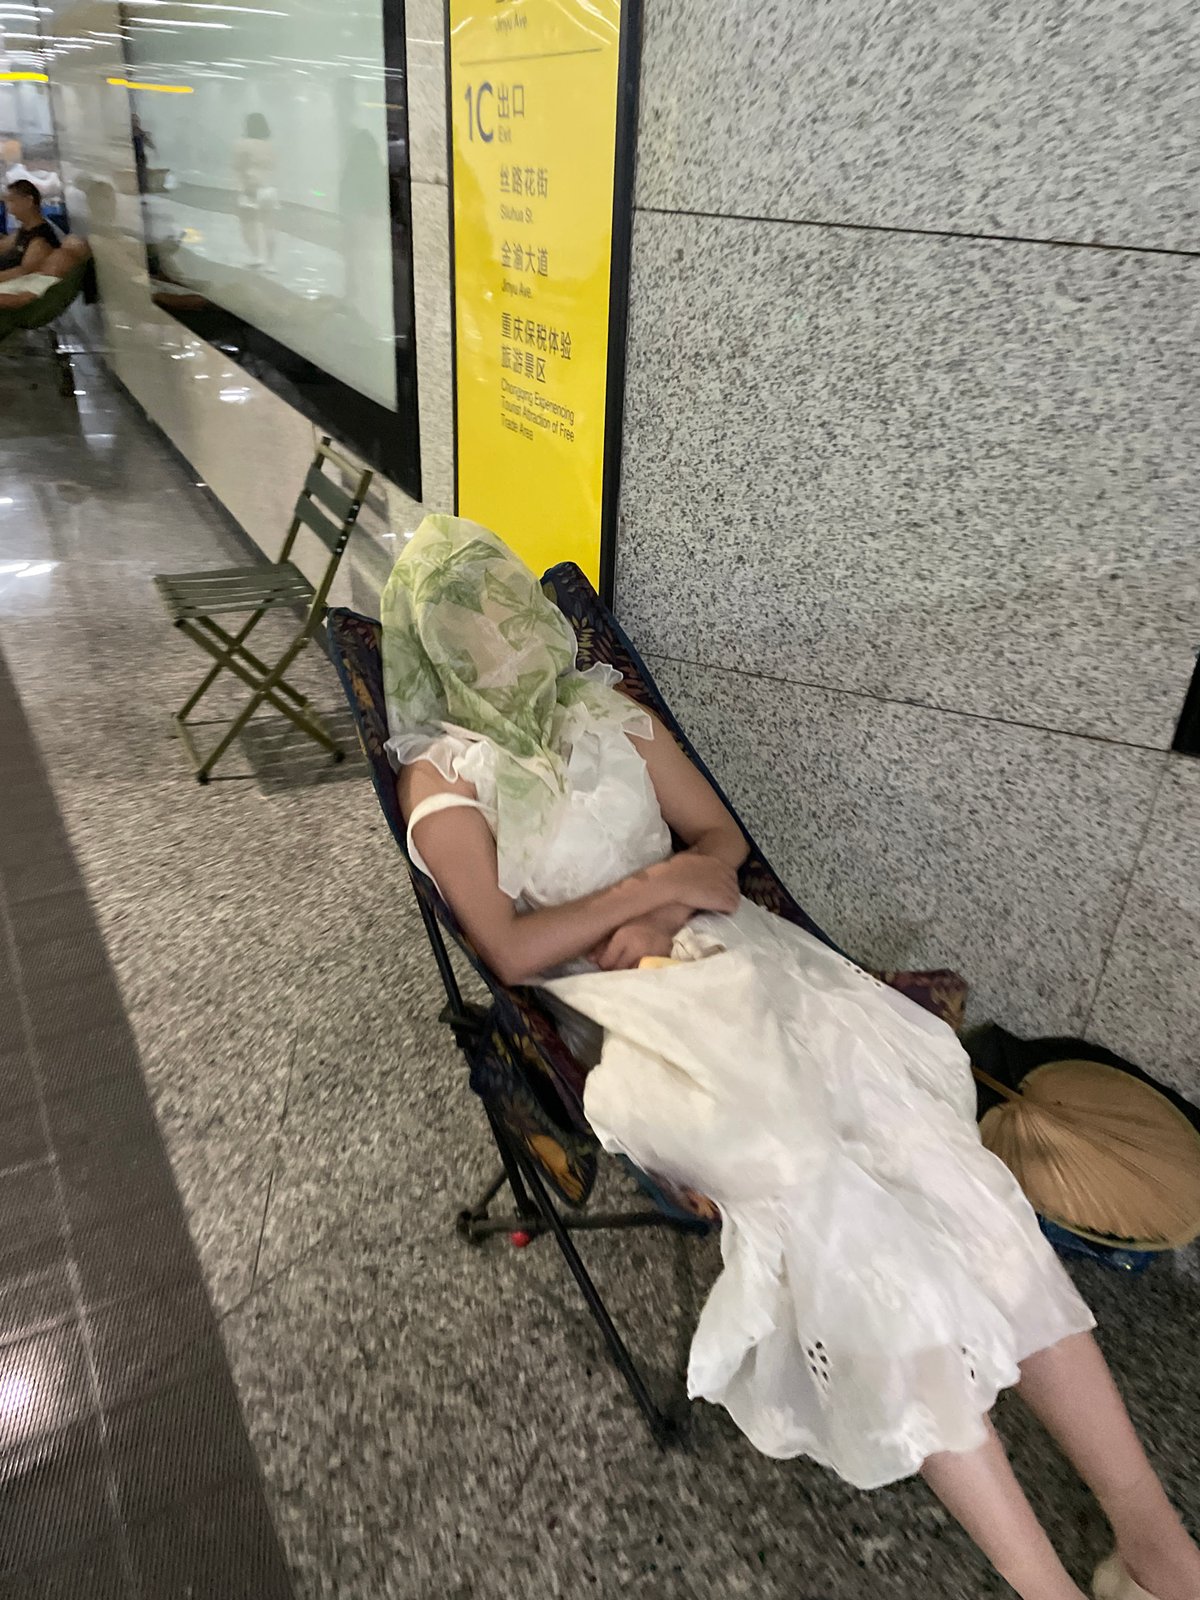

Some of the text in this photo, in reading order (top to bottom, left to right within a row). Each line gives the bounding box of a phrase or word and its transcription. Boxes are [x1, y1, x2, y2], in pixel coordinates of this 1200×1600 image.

[464, 81, 494, 143] 1C
[497, 83, 525, 119] 出口
[499, 164, 548, 199] 丝路花街
[501, 311, 572, 361] 重庆保税体验
[501, 344, 547, 383] 旅游景区
[534, 391, 575, 426] Experiencing
[559, 422, 575, 442] Free
